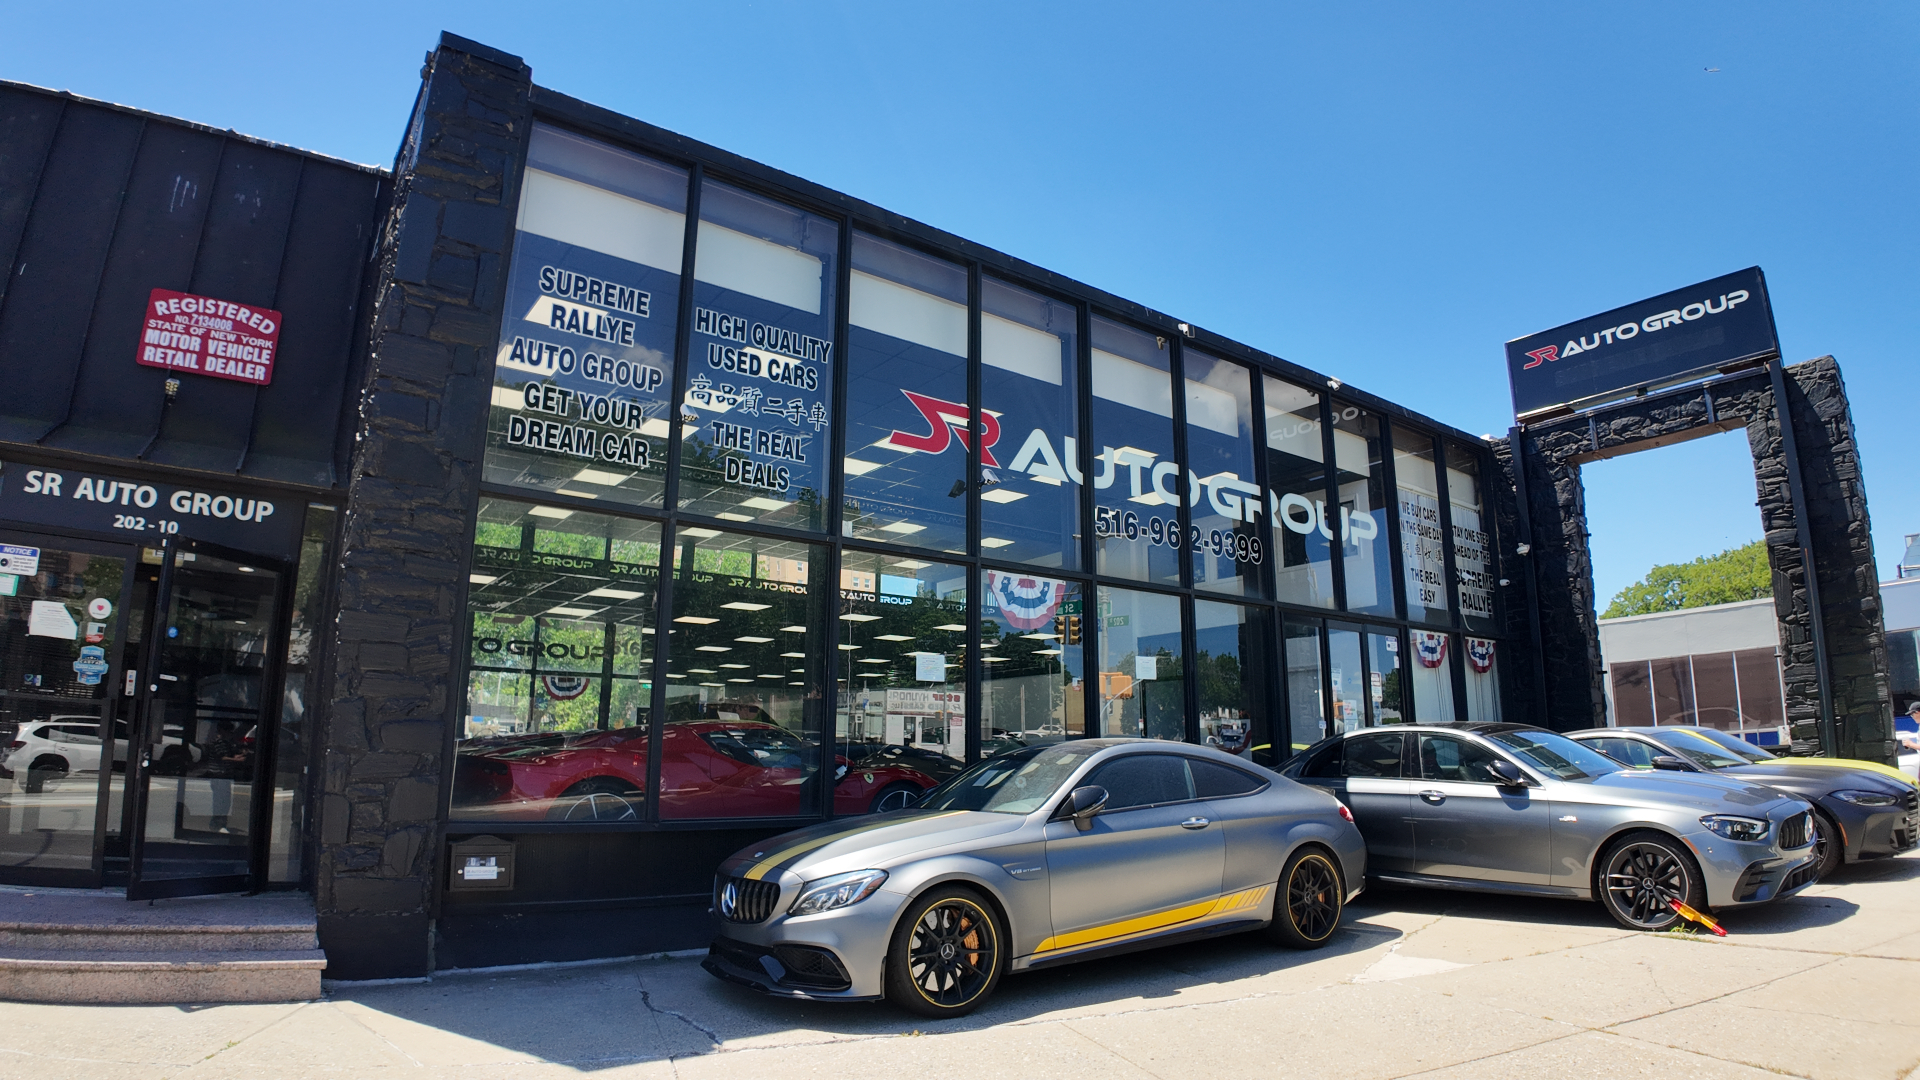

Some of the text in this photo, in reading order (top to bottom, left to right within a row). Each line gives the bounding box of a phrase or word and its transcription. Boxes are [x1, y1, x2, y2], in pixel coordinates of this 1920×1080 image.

[538, 265, 650, 318] SUPREME
[154, 298, 275, 334] REGISTERED
[190, 313, 233, 331] 7134008
[550, 303, 635, 347] RALLYE
[1522, 289, 1749, 370] SR AUTO GROUP
[144, 328, 272, 364] MOTOR VEHICLE
[147, 319, 273, 349] STATE OF NEW YORK
[695, 307, 833, 364] HIGH QUALITY
[143, 346, 266, 381] RETAIL DEALER
[509, 336, 664, 393] AUTO GROUP
[707, 342, 818, 391] USED CARS
[523, 381, 644, 430] GET YOUR
[689, 374, 829, 432] 高品質二手車
[507, 414, 650, 468] DREAM CAR
[711, 421, 806, 463] THE REAL
[725, 457, 790, 492] DEALS
[888, 388, 1378, 546] SR AUTO GROUP
[23, 470, 274, 523] SR AUTO GROUP
[1401, 501, 1410, 515] WE
[1422, 506, 1437, 523] CARS
[1095, 505, 1263, 565] 516-962-9399
[1406, 520, 1416, 535] THE
[1417, 523, 1432, 540] SAME
[1452, 525, 1489, 547] TAY ONE STEP
[4, 547, 33, 555] NOTICE
[543, 556, 594, 569] GROUP
[1471, 548, 1479, 561] OF
[1480, 550, 1491, 565] THE
[630, 567, 660, 578] AUT
[1410, 568, 1441, 586] THE REAL
[847, 591, 876, 602] AUTO
[1419, 588, 1435, 603] EASY
[1461, 592, 1493, 614] RALLYE
